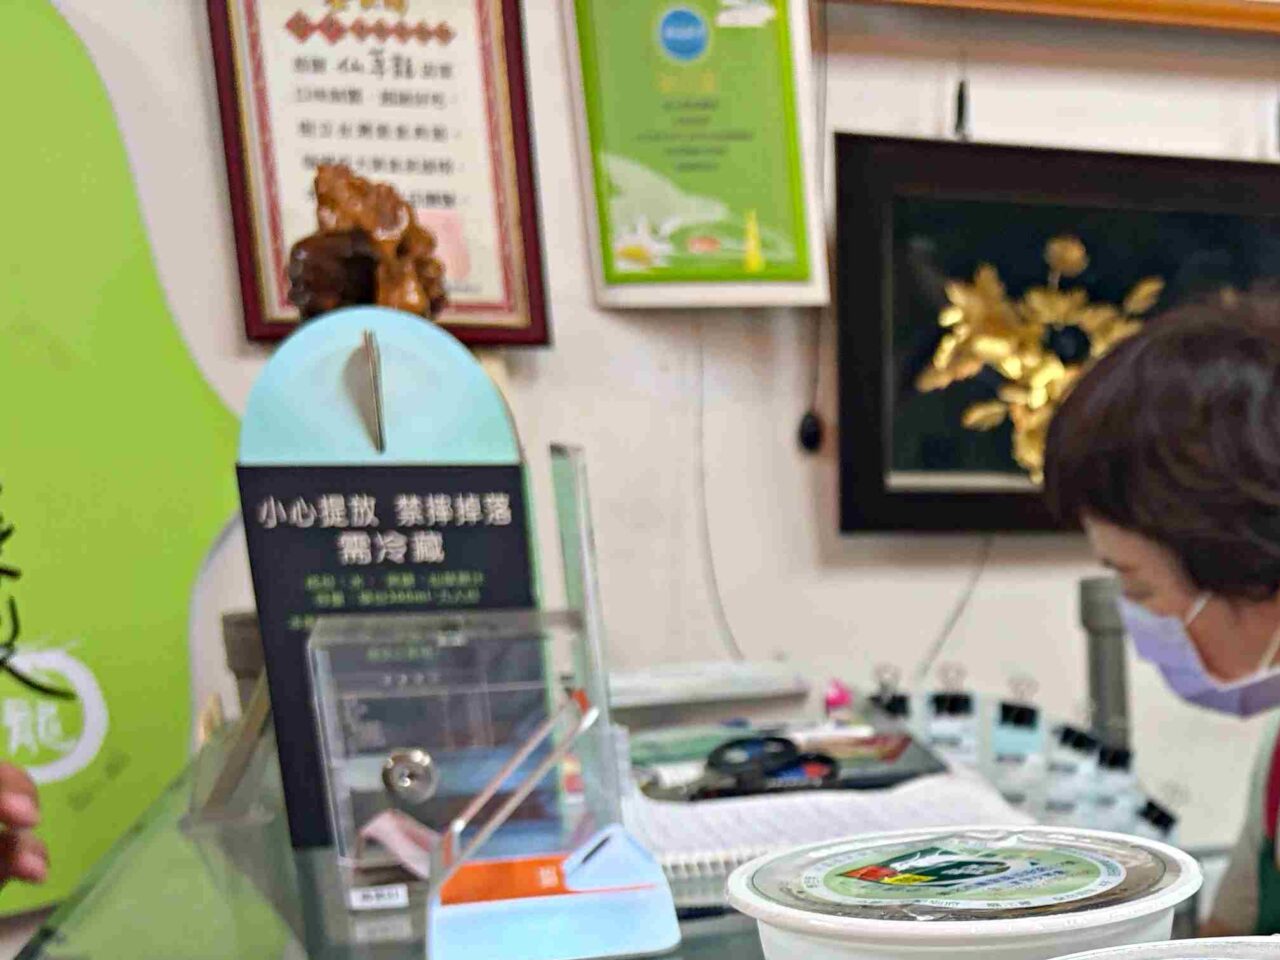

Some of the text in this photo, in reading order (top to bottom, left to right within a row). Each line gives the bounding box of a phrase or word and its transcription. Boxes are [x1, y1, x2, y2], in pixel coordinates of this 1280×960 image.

[258, 494, 379, 528] 小心提放
[338, 530, 445, 565] 需冷藏
